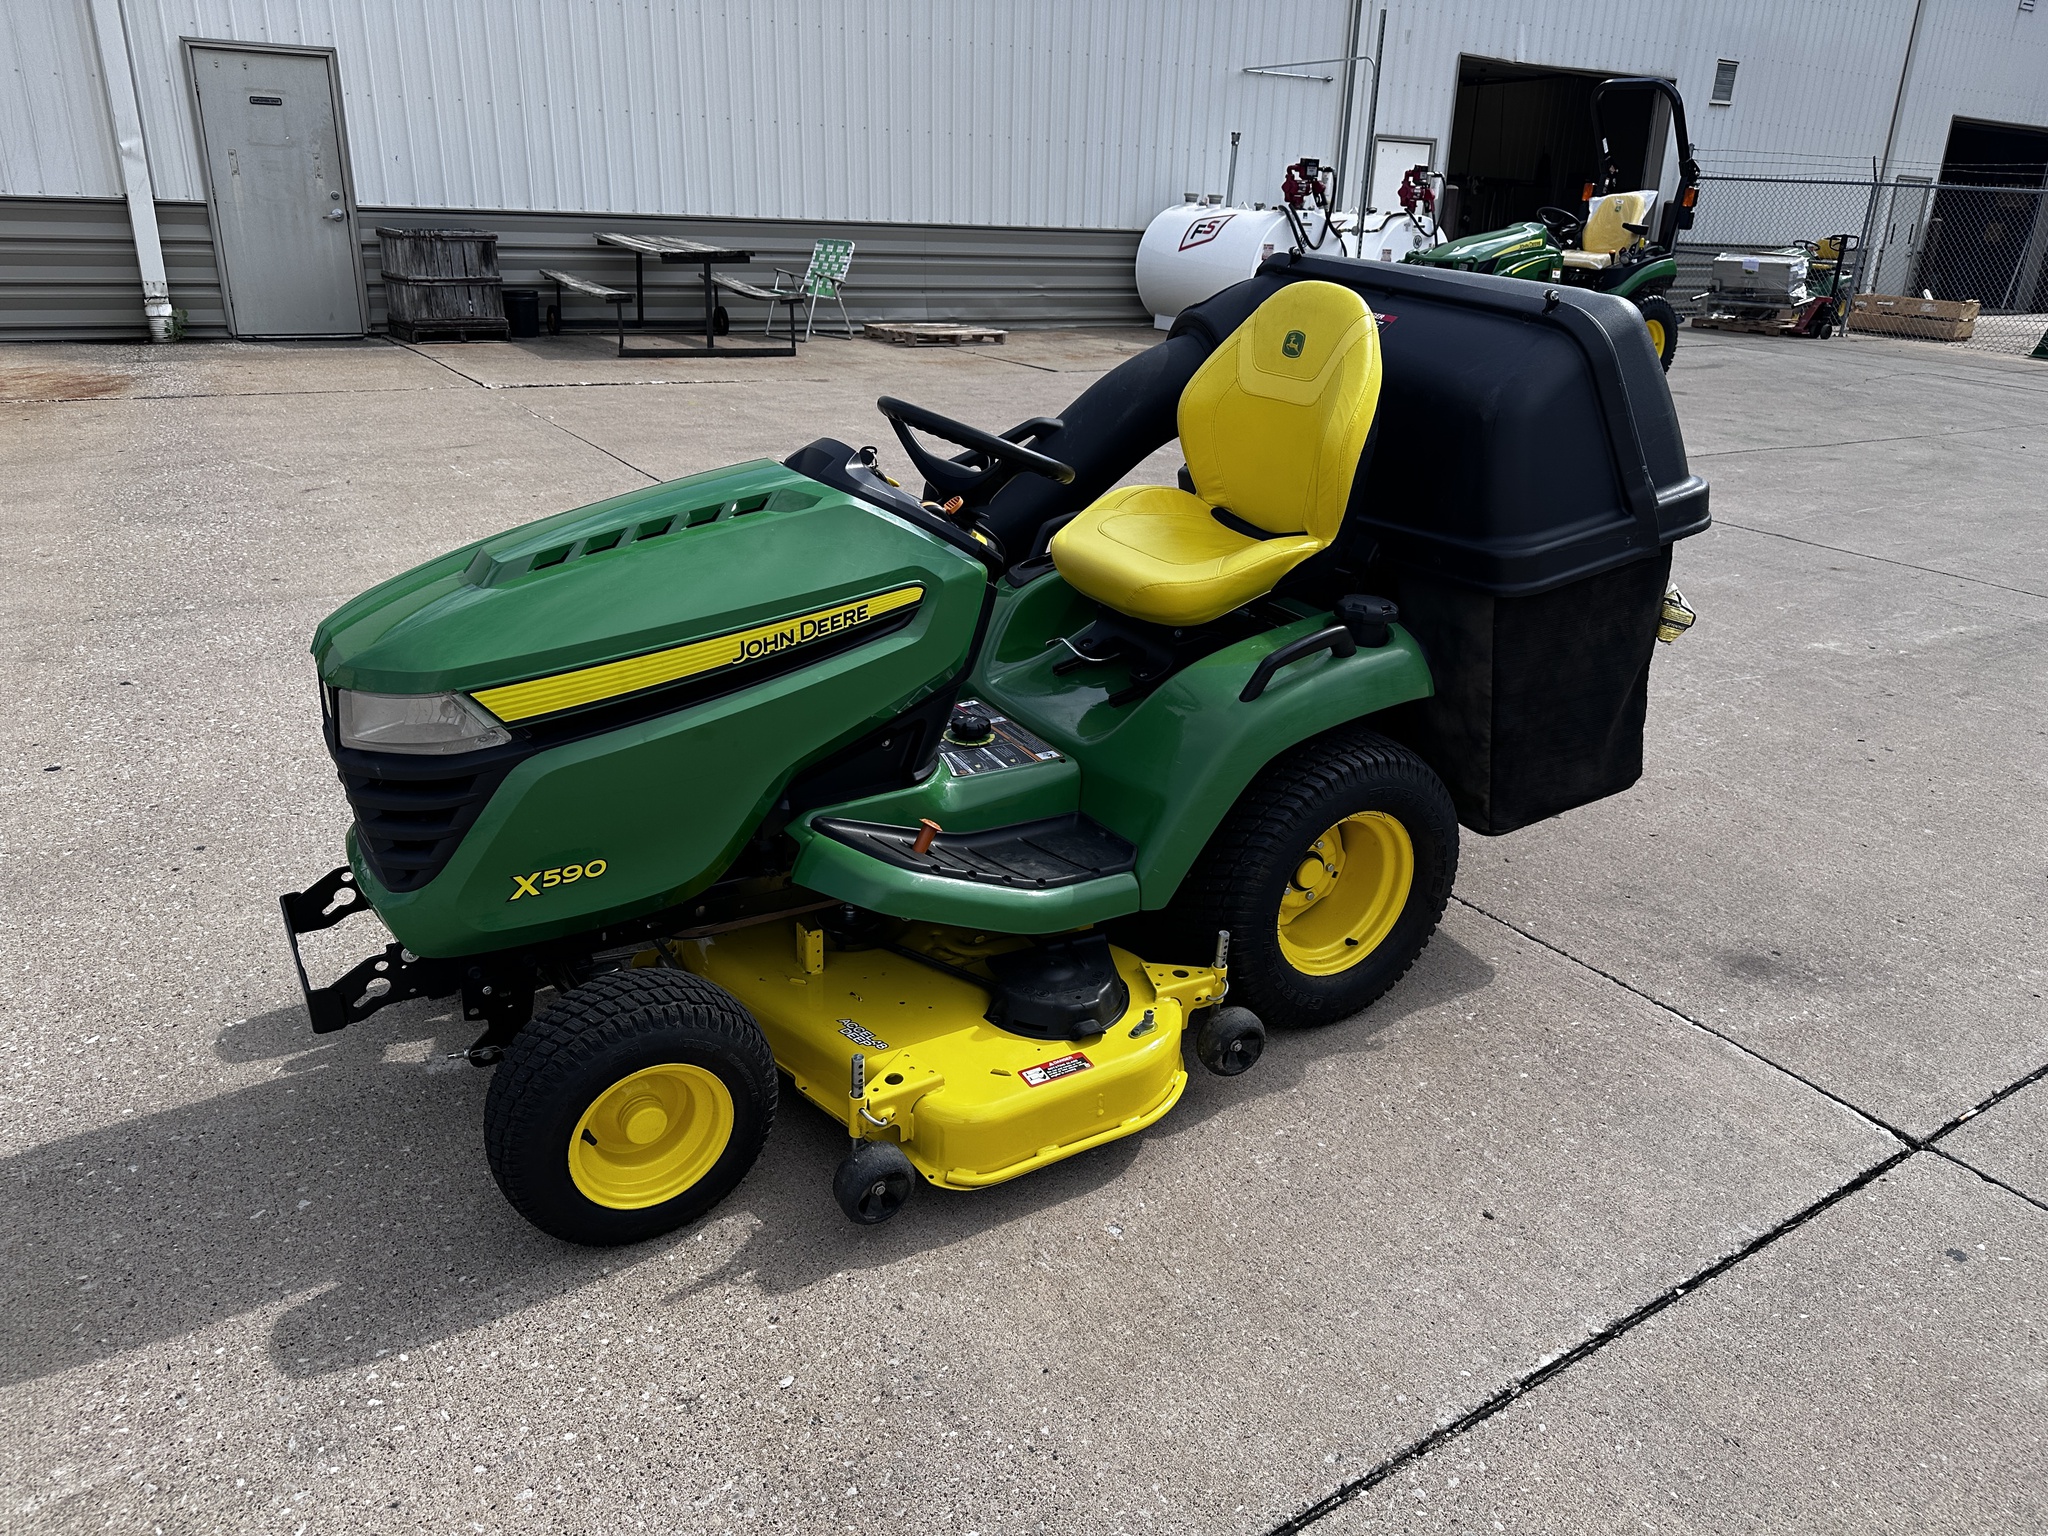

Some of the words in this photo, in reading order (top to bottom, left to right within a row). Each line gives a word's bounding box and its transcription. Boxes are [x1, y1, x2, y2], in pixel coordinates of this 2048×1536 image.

[1190, 220, 1221, 240] FS
[732, 628, 796, 664] JOHN
[800, 603, 870, 643] DEERE
[507, 858, 608, 902] X590
[836, 1018, 876, 1042] ACCEL
[838, 1027, 875, 1046] DEEP
